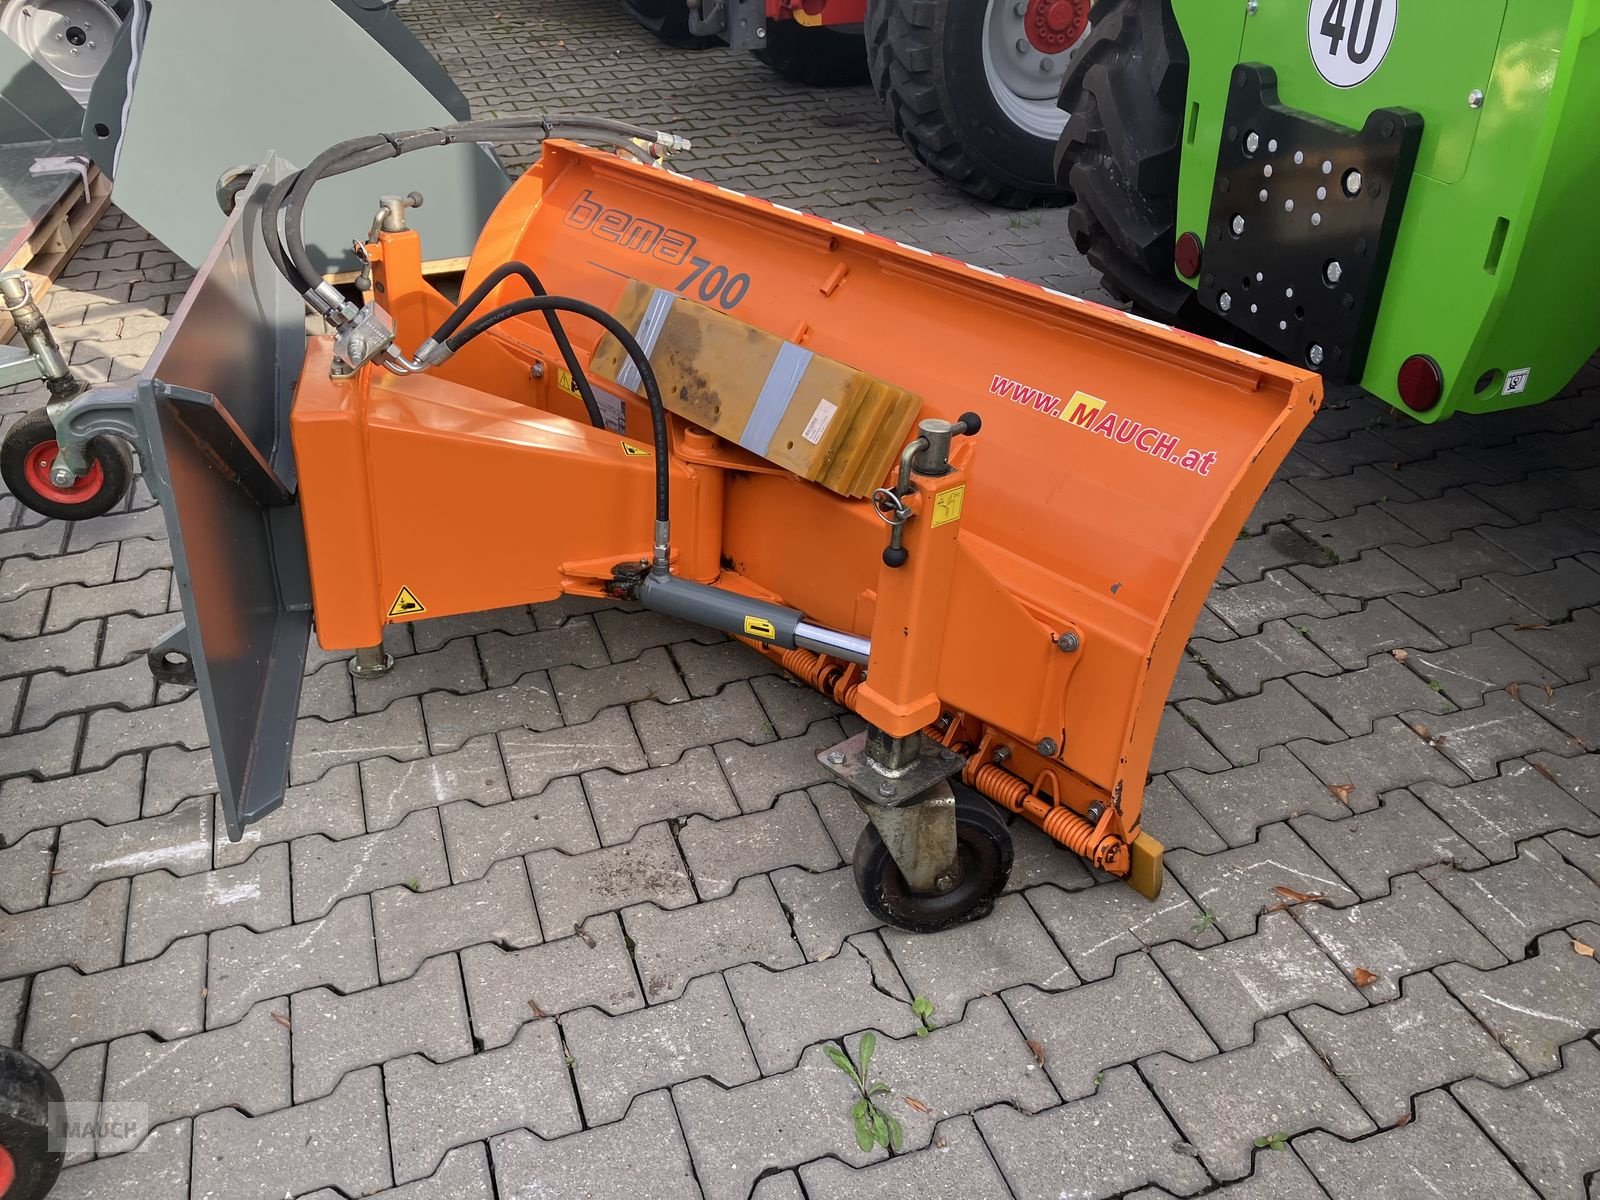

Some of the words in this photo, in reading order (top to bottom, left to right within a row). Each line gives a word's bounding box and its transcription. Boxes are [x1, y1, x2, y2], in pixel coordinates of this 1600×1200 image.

[1320, 0, 1382, 64] 40
[563, 189, 697, 265] bema
[675, 256, 750, 310] 700
[989, 375, 1217, 476] www.MAUCH.at
